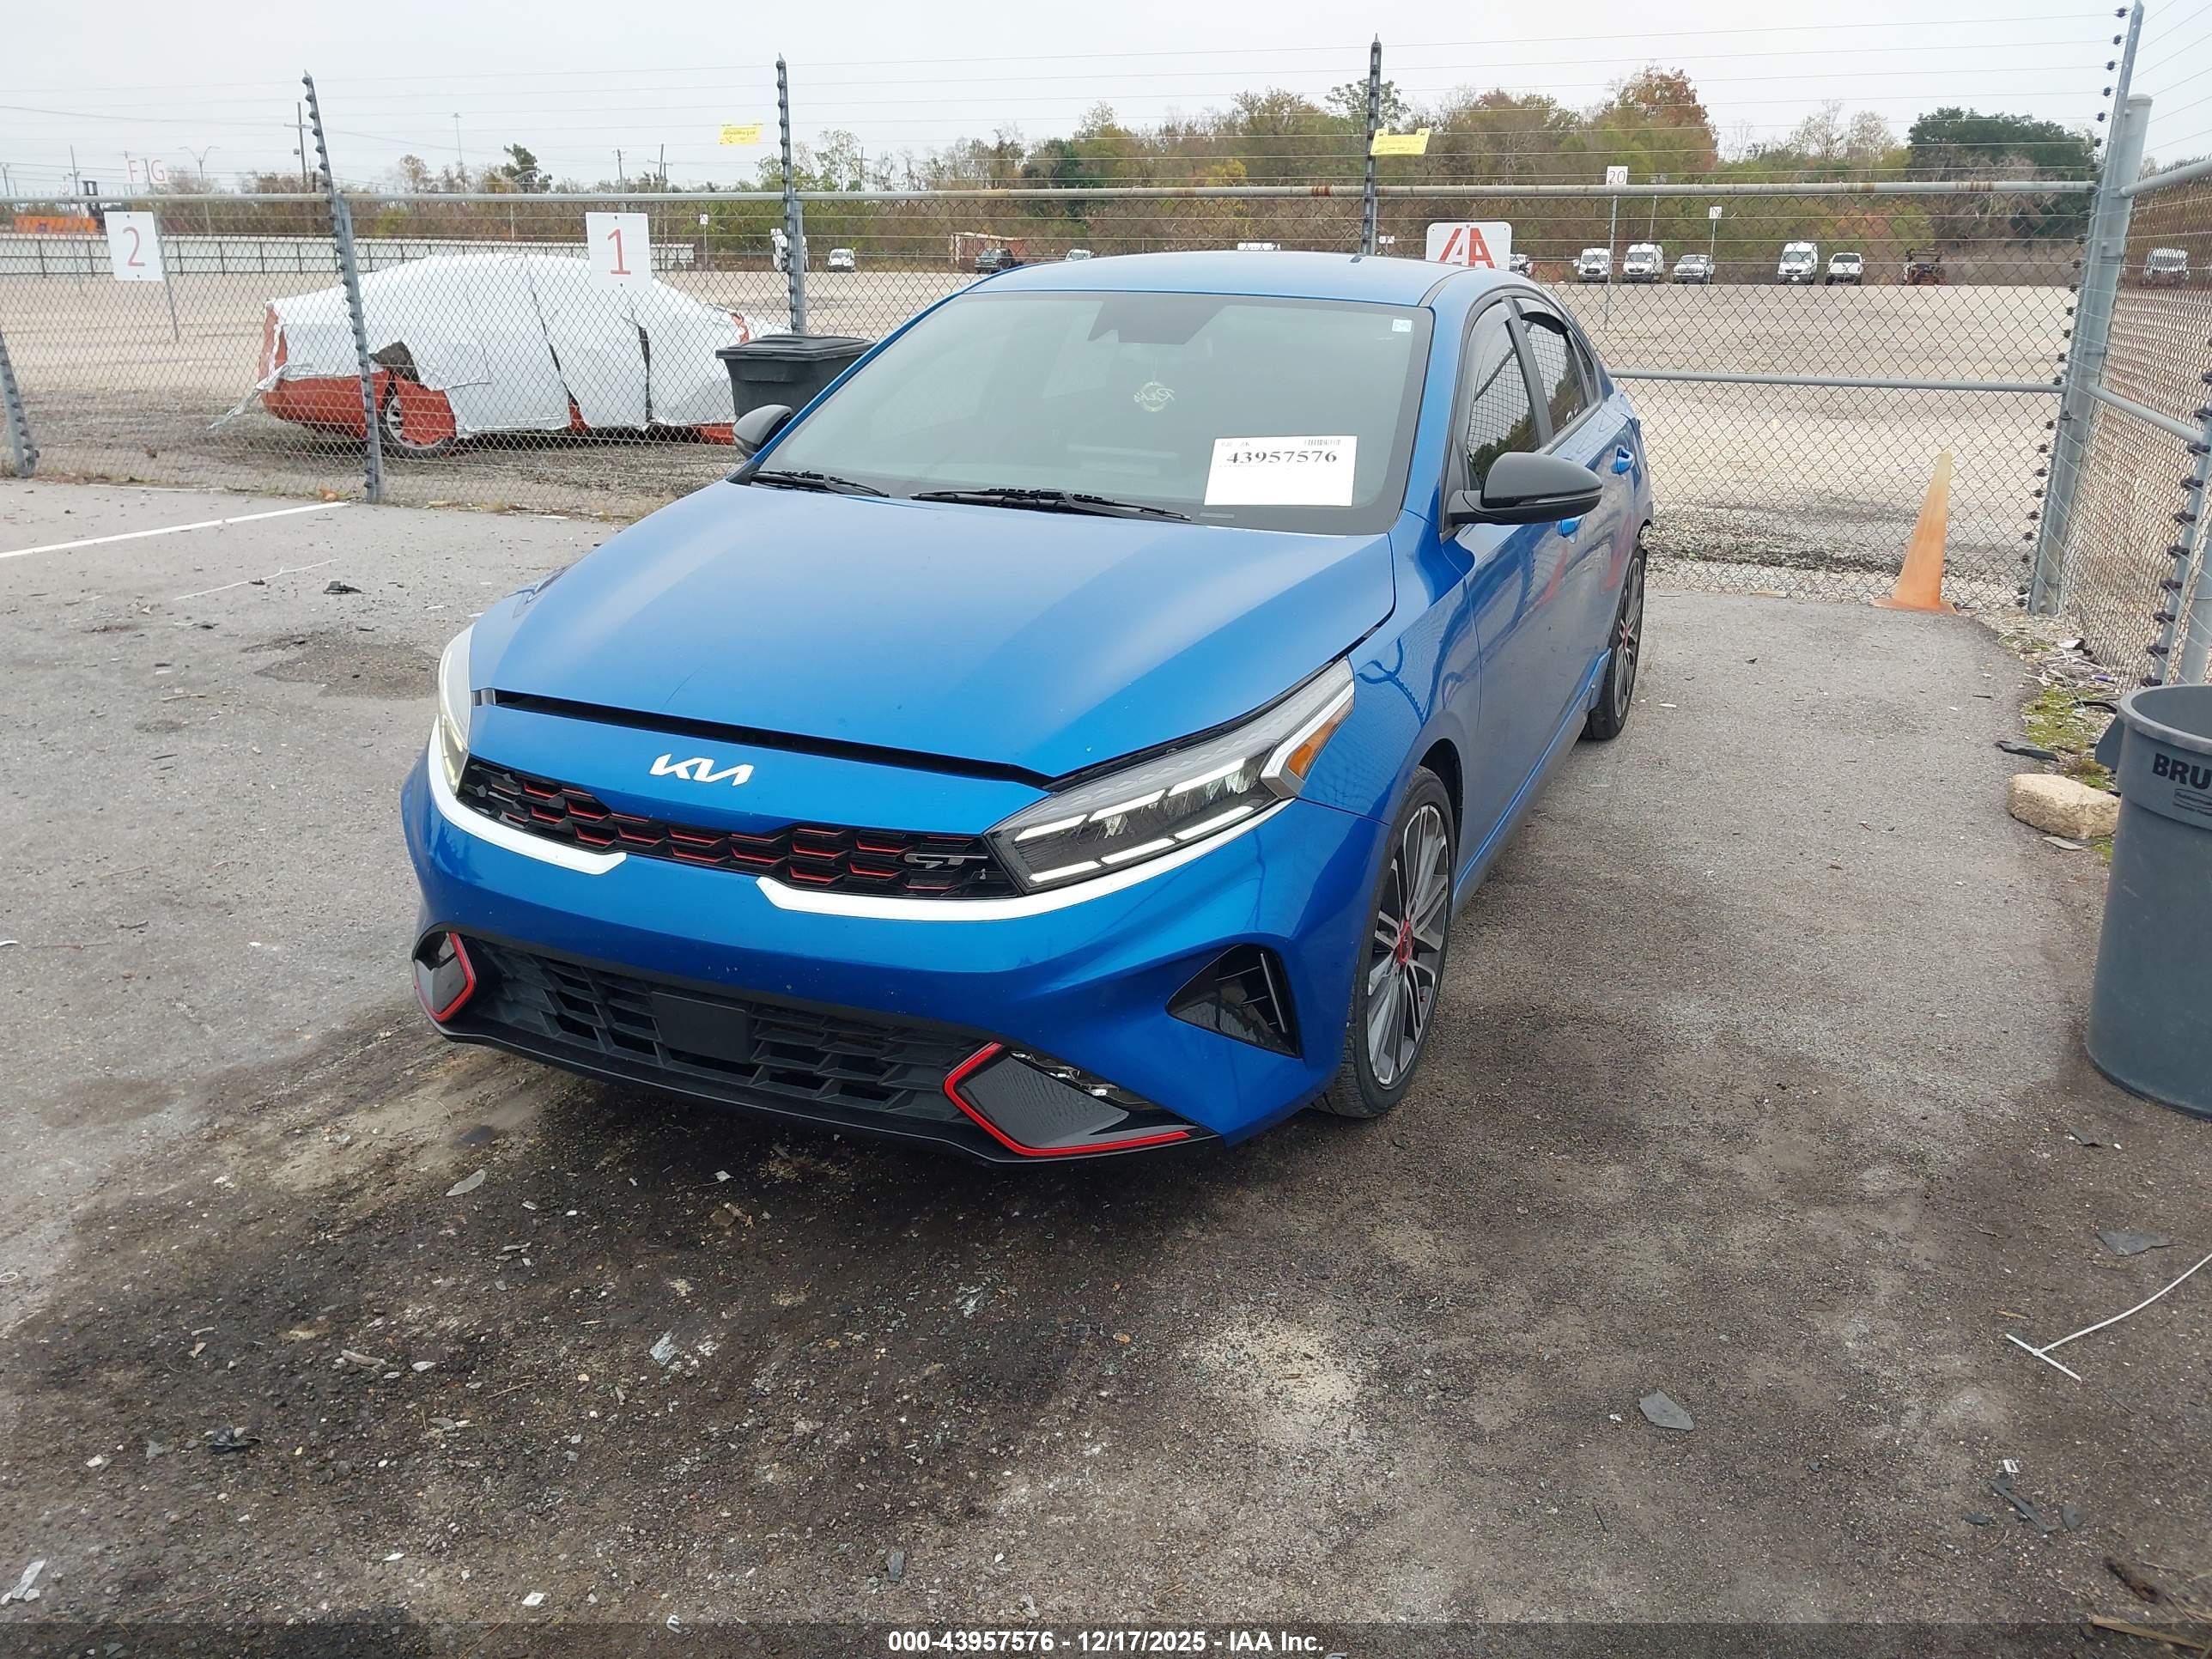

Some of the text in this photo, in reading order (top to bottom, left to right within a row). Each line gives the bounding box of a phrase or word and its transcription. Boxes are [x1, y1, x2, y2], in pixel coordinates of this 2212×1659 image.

[127, 160, 138, 182] F
[151, 159, 166, 182] G
[1608, 170, 1626, 184] 20
[123, 226, 145, 267] 2
[607, 228, 631, 275] 1
[1226, 450, 1338, 465] 43957576
[2152, 752, 2212, 789] BRU
[904, 853, 988, 869] GT
